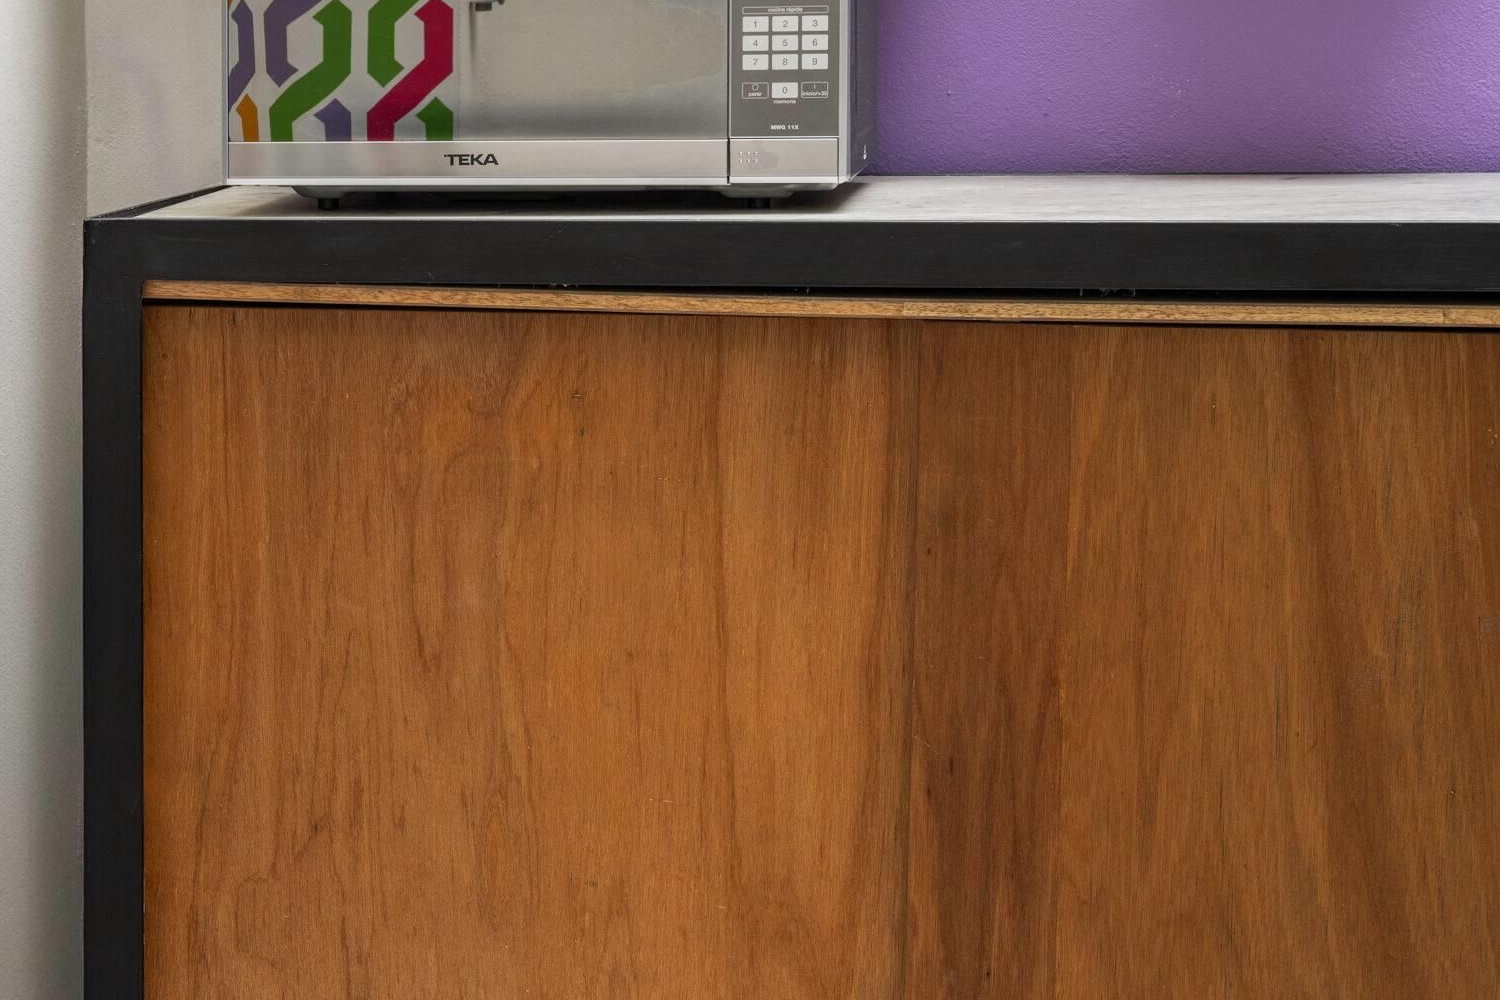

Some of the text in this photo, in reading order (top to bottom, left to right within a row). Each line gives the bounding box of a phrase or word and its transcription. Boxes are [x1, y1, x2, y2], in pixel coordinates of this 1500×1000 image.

[782, 20, 789, 28] 2
[752, 39, 758, 47] 4
[782, 39, 788, 47] 5
[752, 58, 758, 66] 7
[782, 58, 788, 66] 8
[444, 153, 499, 166] TEKA
